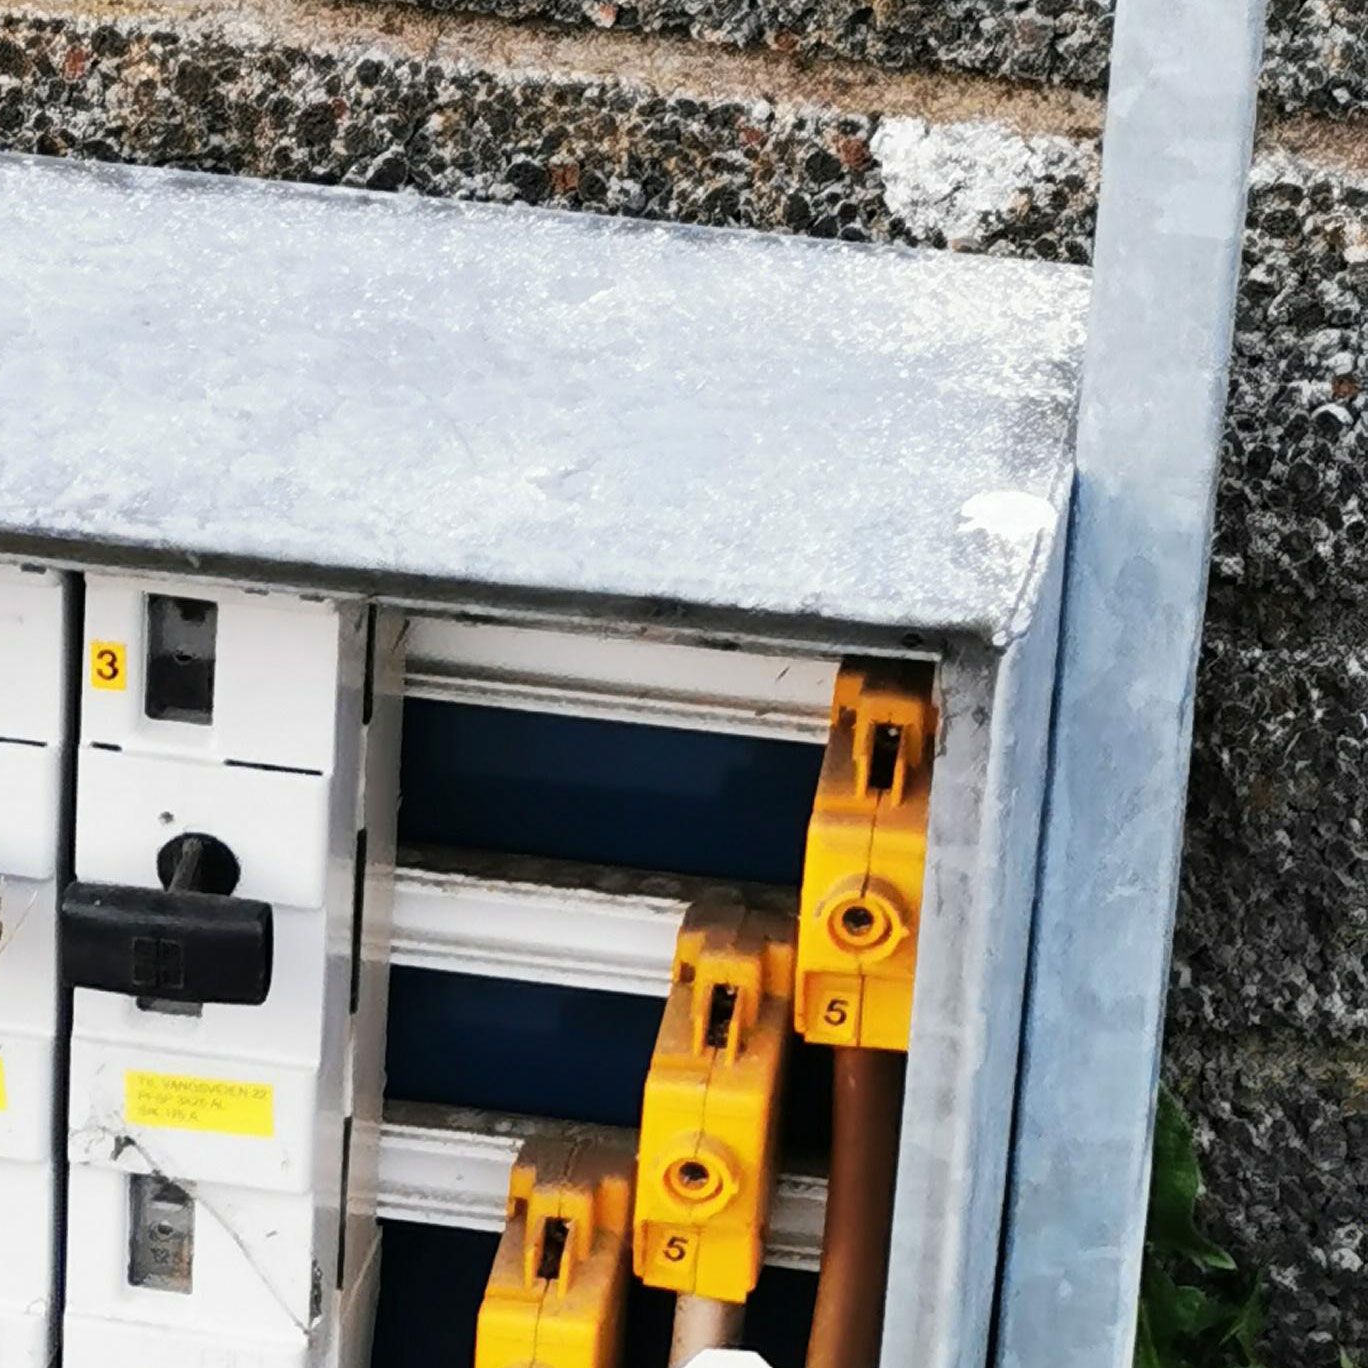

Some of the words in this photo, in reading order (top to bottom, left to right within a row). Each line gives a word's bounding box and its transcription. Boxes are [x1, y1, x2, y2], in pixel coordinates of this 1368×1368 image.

[96, 651, 119, 680] 3
[825, 1000, 848, 1026] 5
[664, 1236, 688, 1263] 5
